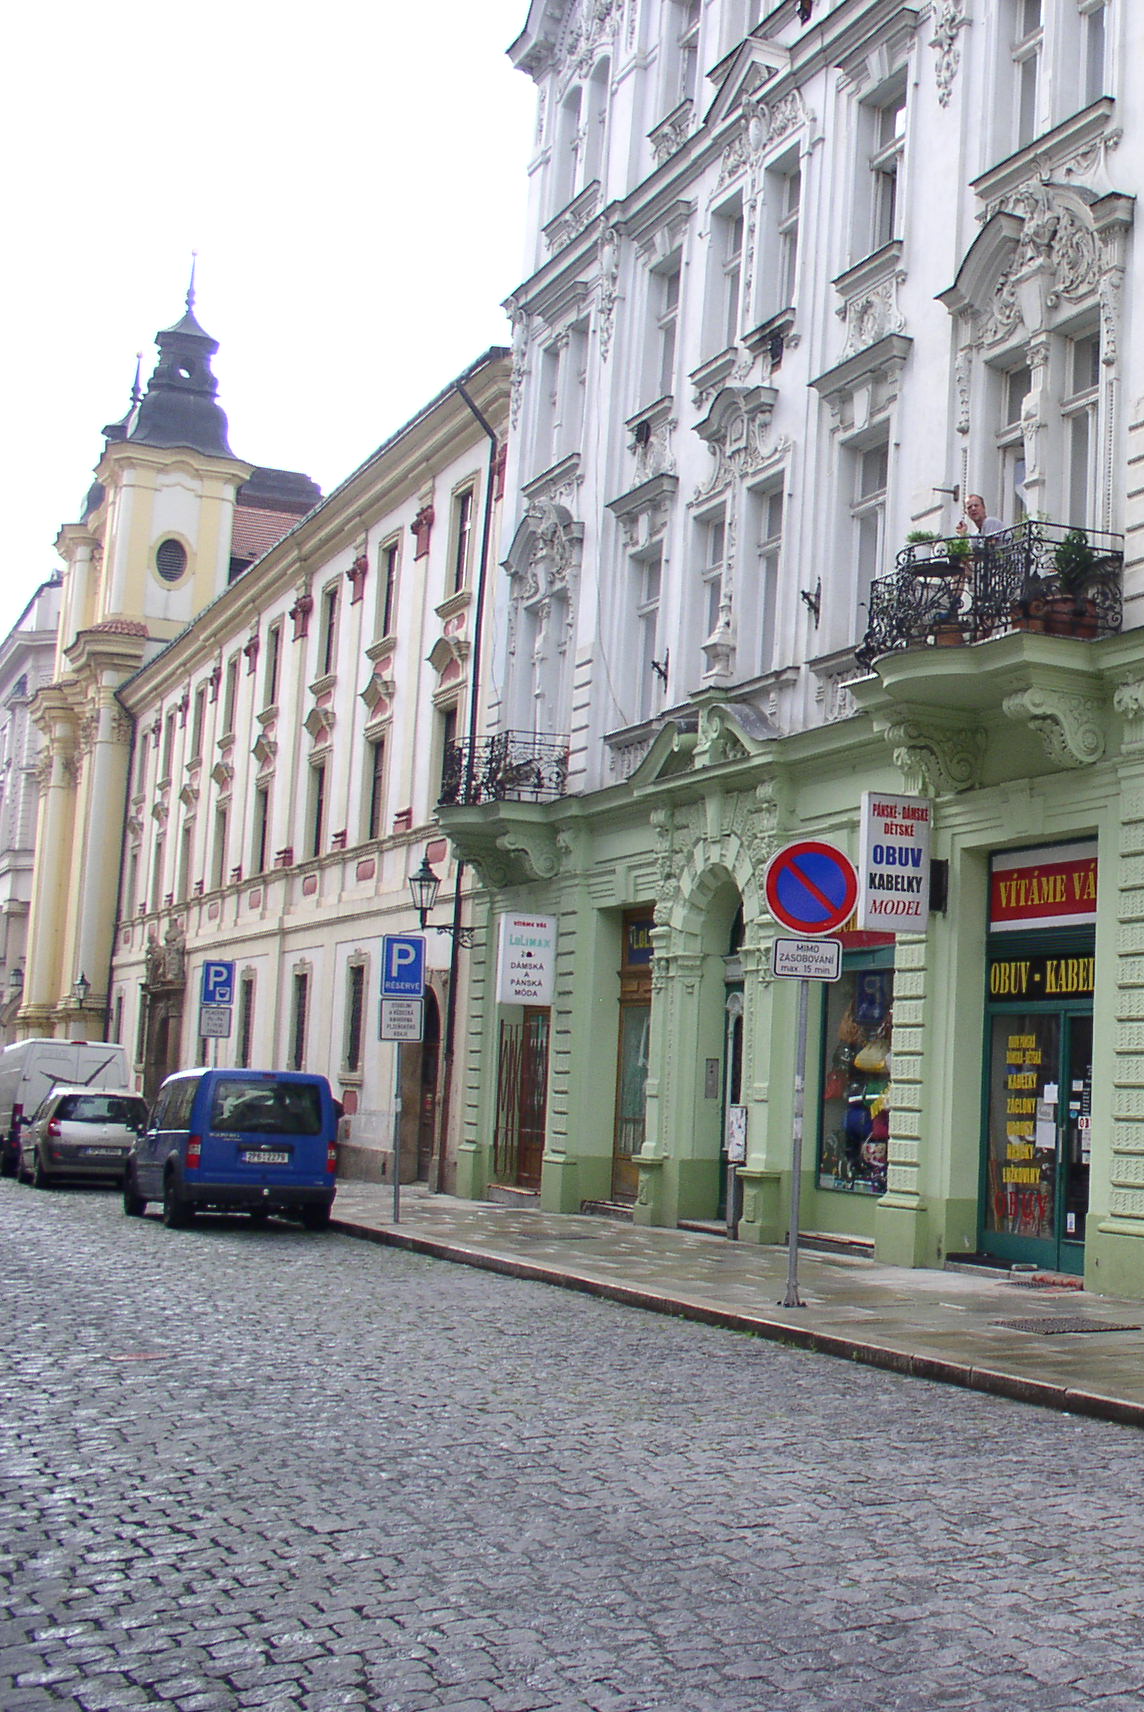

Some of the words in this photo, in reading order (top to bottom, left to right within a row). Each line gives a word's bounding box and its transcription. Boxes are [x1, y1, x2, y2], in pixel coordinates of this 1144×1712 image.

[873, 844, 922, 868] OBUV
[869, 872, 923, 893] KABELKY
[1000, 870, 1067, 908] VÍTÁME
[1073, 863, 1096, 900] VÁ
[869, 900, 922, 916] MODEL
[796, 944, 820, 953] MIMO
[391, 943, 416, 977] P
[510, 960, 545, 971] DÁMSKÁ
[803, 965, 811, 973] 15
[209, 966, 228, 991] P
[510, 977, 543, 987] PÁNSKÁ
[990, 961, 1030, 994] OBUV
[514, 987, 538, 997] MÓDA
